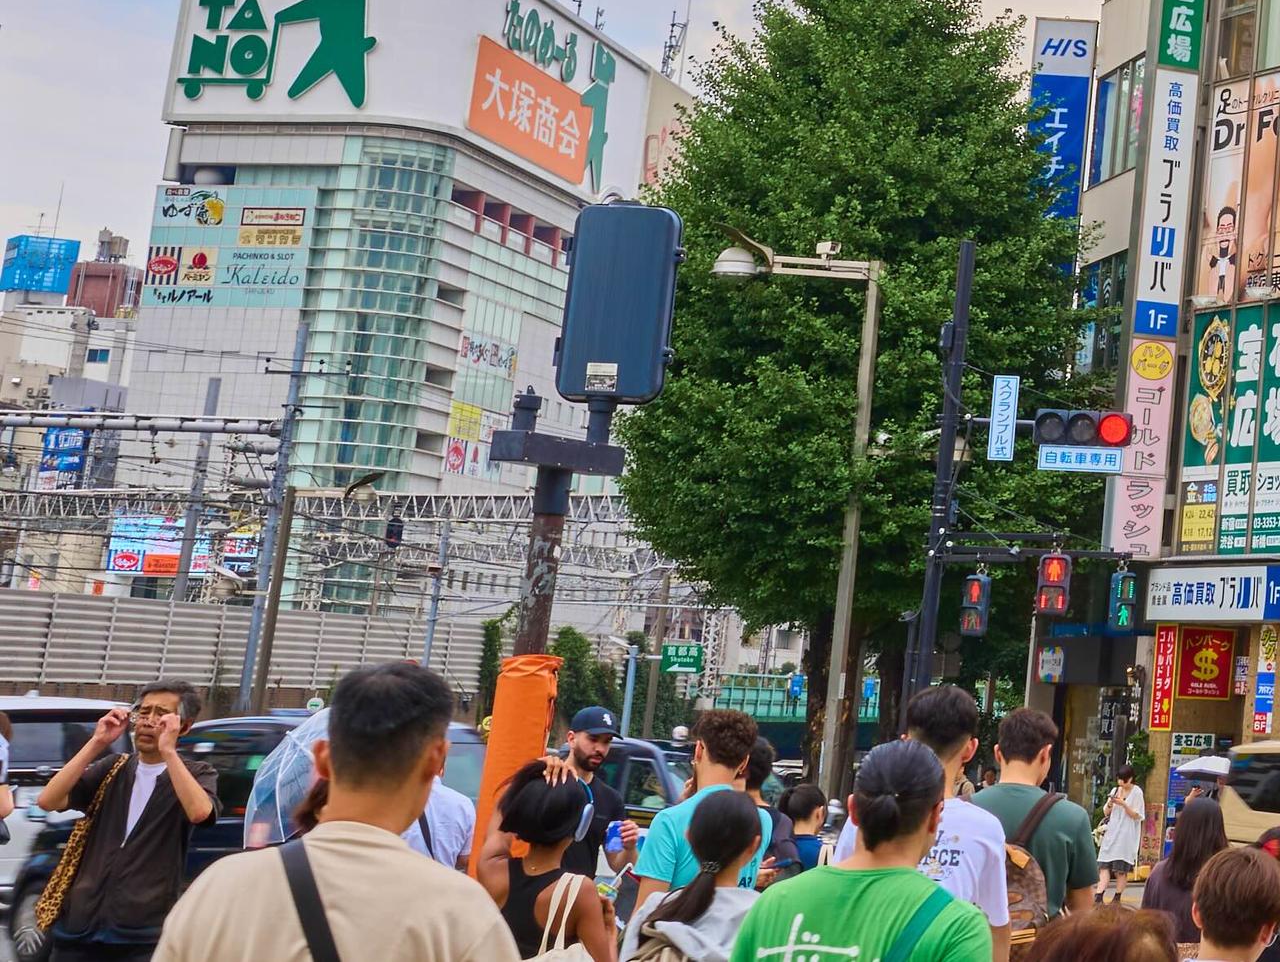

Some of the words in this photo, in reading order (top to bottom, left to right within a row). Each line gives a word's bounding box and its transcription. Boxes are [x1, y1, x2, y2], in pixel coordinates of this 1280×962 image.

[1041, 38, 1087, 58] HIS
[481, 68, 581, 159] 大塚商会
[1164, 81, 1184, 153] 高価買取
[1213, 118, 1246, 152] Dr
[1150, 157, 1182, 292] ブラリバ
[233, 252, 270, 260] PACHINKO
[277, 253, 295, 261] SLOT
[222, 264, 299, 286] Kaleido
[1148, 308, 1168, 332] 1F
[995, 379, 1012, 458] スクランブル式
[1044, 450, 1118, 467] 自転車専用
[1123, 386, 1166, 557] ゴールドラッシュ
[1171, 582, 1216, 607] 高価買取
[1269, 580, 1280, 605] 1F
[667, 646, 699, 656] 首都高
[1186, 634, 1231, 652] ハンバーグ
[1164, 630, 1175, 691] ハンバーグ
[1153, 630, 1166, 724] ゴールドラッシュ
[1254, 722, 1266, 732] 6F
[1173, 734, 1213, 747] 宝石広場
